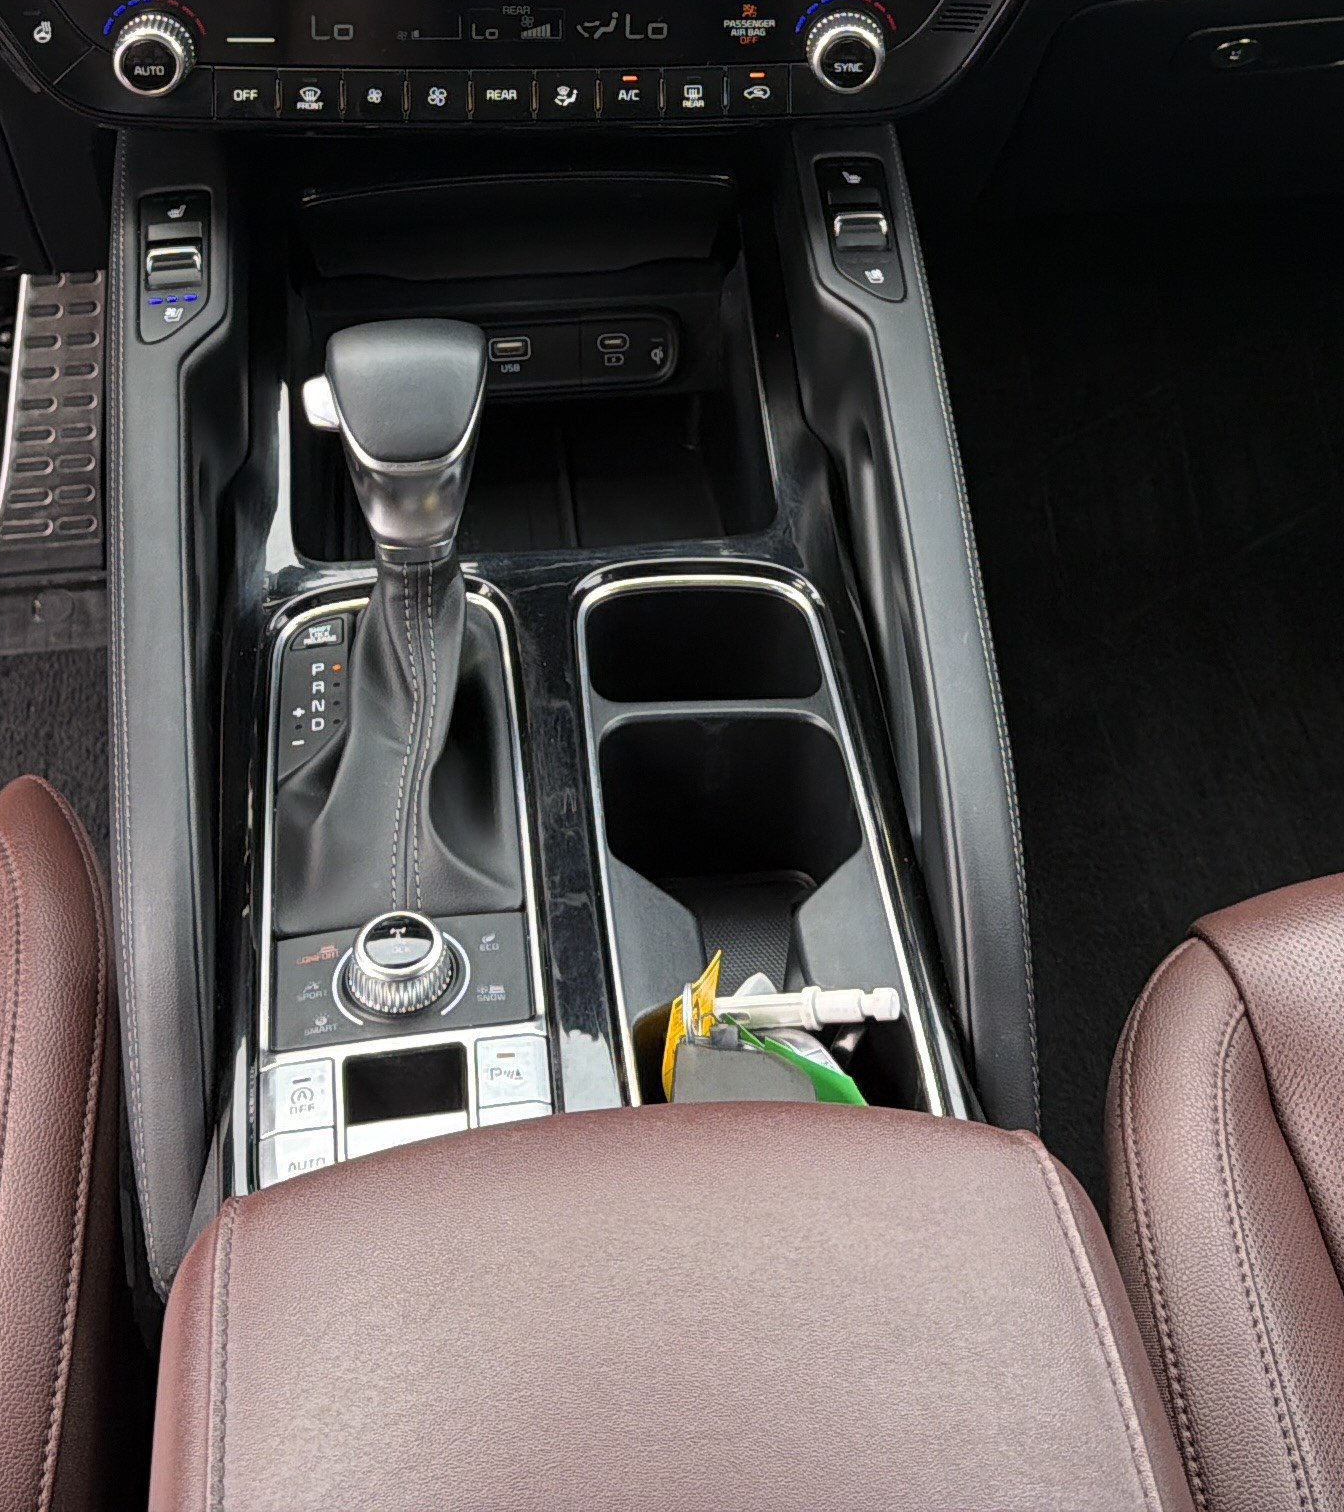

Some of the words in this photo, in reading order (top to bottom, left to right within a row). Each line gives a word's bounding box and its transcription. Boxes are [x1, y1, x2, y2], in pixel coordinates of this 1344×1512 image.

[502, 5, 531, 15] REAR
[723, 20, 776, 28] PASSENGER
[731, 28, 746, 36] AIR
[747, 28, 766, 36] BAG
[739, 36, 759, 45] OFF
[134, 66, 164, 76] AUTO
[833, 62, 863, 73] SYNC
[233, 90, 258, 101] OFF
[486, 90, 517, 101] REAR
[618, 89, 640, 101] A/C
[297, 101, 324, 110] FRONT
[682, 100, 705, 108] REAR
[500, 364, 521, 373] USB
[311, 663, 325, 676] P
[312, 681, 325, 694] R
[311, 699, 325, 713] N
[311, 717, 325, 731] D
[479, 942, 500, 951] ECO
[297, 989, 328, 1000] SPORT
[476, 994, 506, 1002] SNOW
[304, 1022, 338, 1036] SMART
[288, 1157, 326, 1172] AUTO
